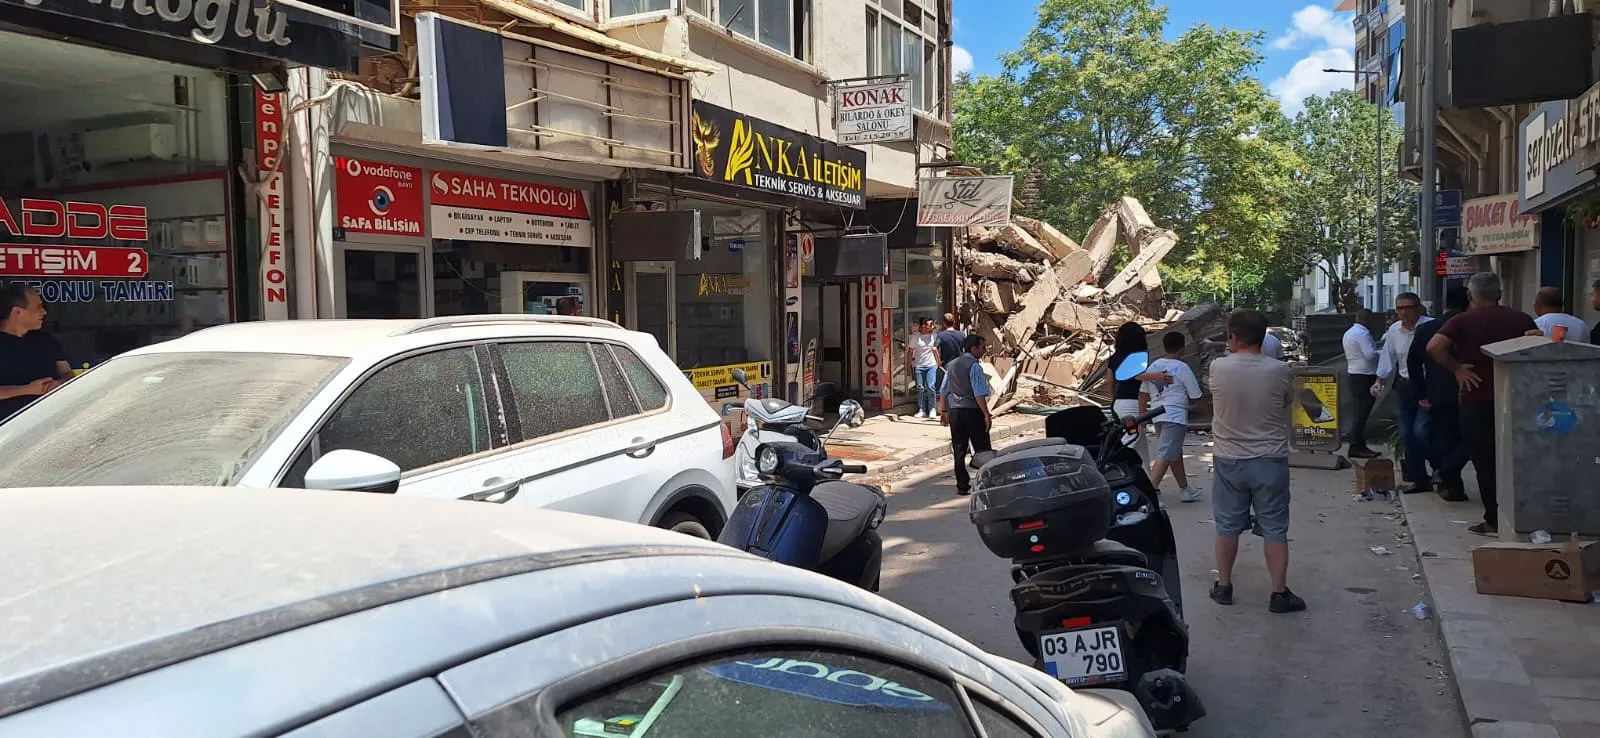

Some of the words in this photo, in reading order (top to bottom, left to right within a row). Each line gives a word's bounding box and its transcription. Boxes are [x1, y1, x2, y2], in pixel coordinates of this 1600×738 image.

[842, 88, 904, 107] KONAK
[876, 109, 882, 119] &
[884, 107, 905, 118] OKEY
[856, 121, 889, 132] SALONU
[724, 119, 811, 185] ANKA
[812, 153, 861, 191] İLETİŞİM
[363, 165, 413, 180] vodafone
[451, 177, 496, 199] SAHA
[754, 174, 787, 192] TEKNİK
[788, 182, 816, 198] SERVİS
[817, 187, 823, 199] &
[825, 189, 861, 205] AKSESUAR
[944, 179, 984, 200] Stil
[494, 216, 513, 225] LAPTOP
[1466, 201, 1507, 232] BUKET
[266, 176, 285, 303] TELEFON
[464, 227, 475, 235] CEP
[127, 252, 142, 273] 2
[864, 277, 879, 386] KUAFÖR
[1044, 636, 1068, 656] 03
[1075, 630, 1117, 653] AJR
[1083, 652, 1121, 674] 790
